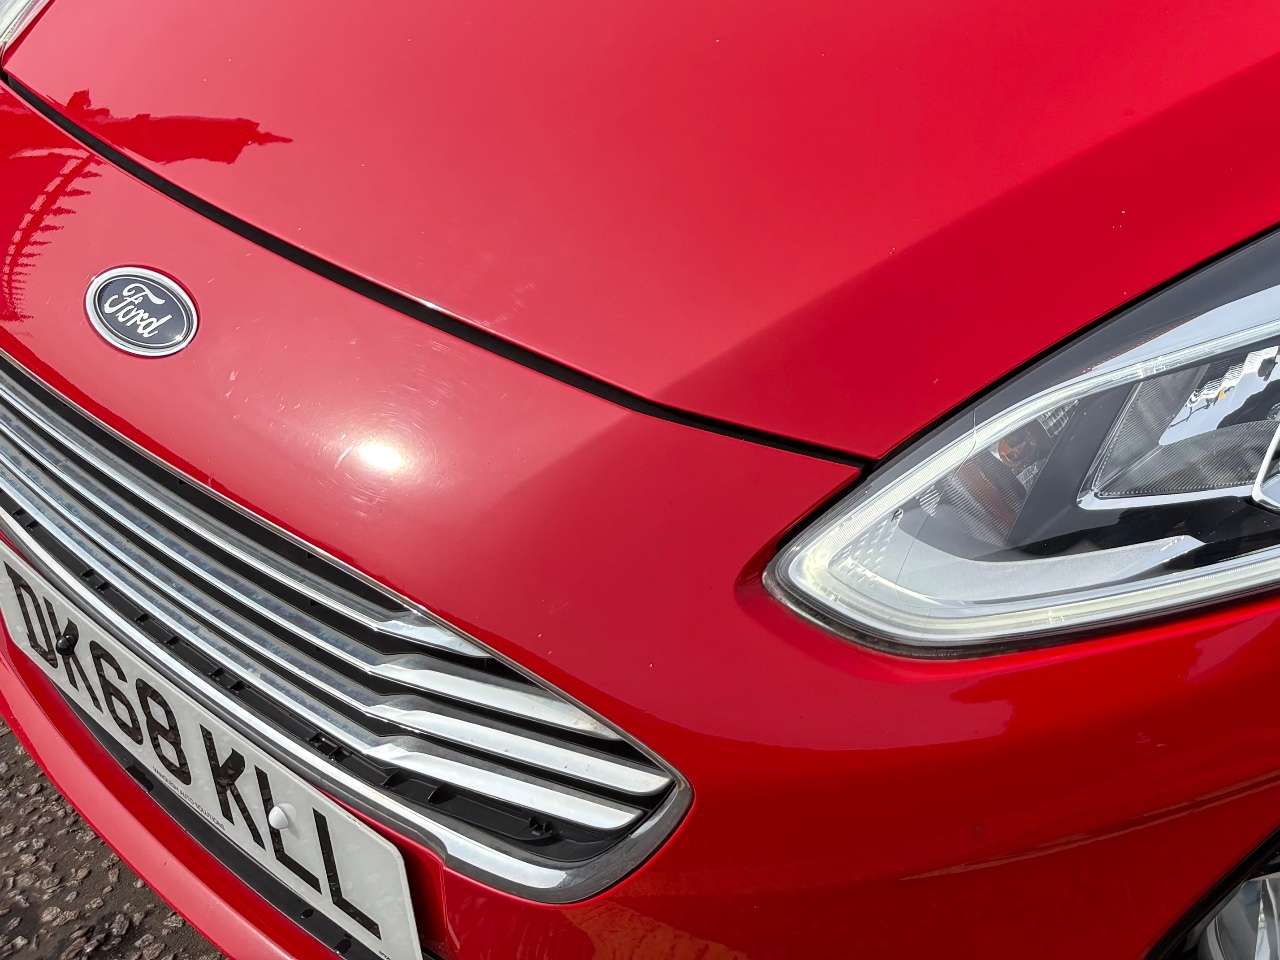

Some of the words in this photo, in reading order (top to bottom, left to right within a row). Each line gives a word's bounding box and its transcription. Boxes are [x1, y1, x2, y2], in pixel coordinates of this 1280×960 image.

[104, 283, 172, 337] Ford
[4, 561, 191, 785] DK68
[200, 724, 382, 940] KLL
